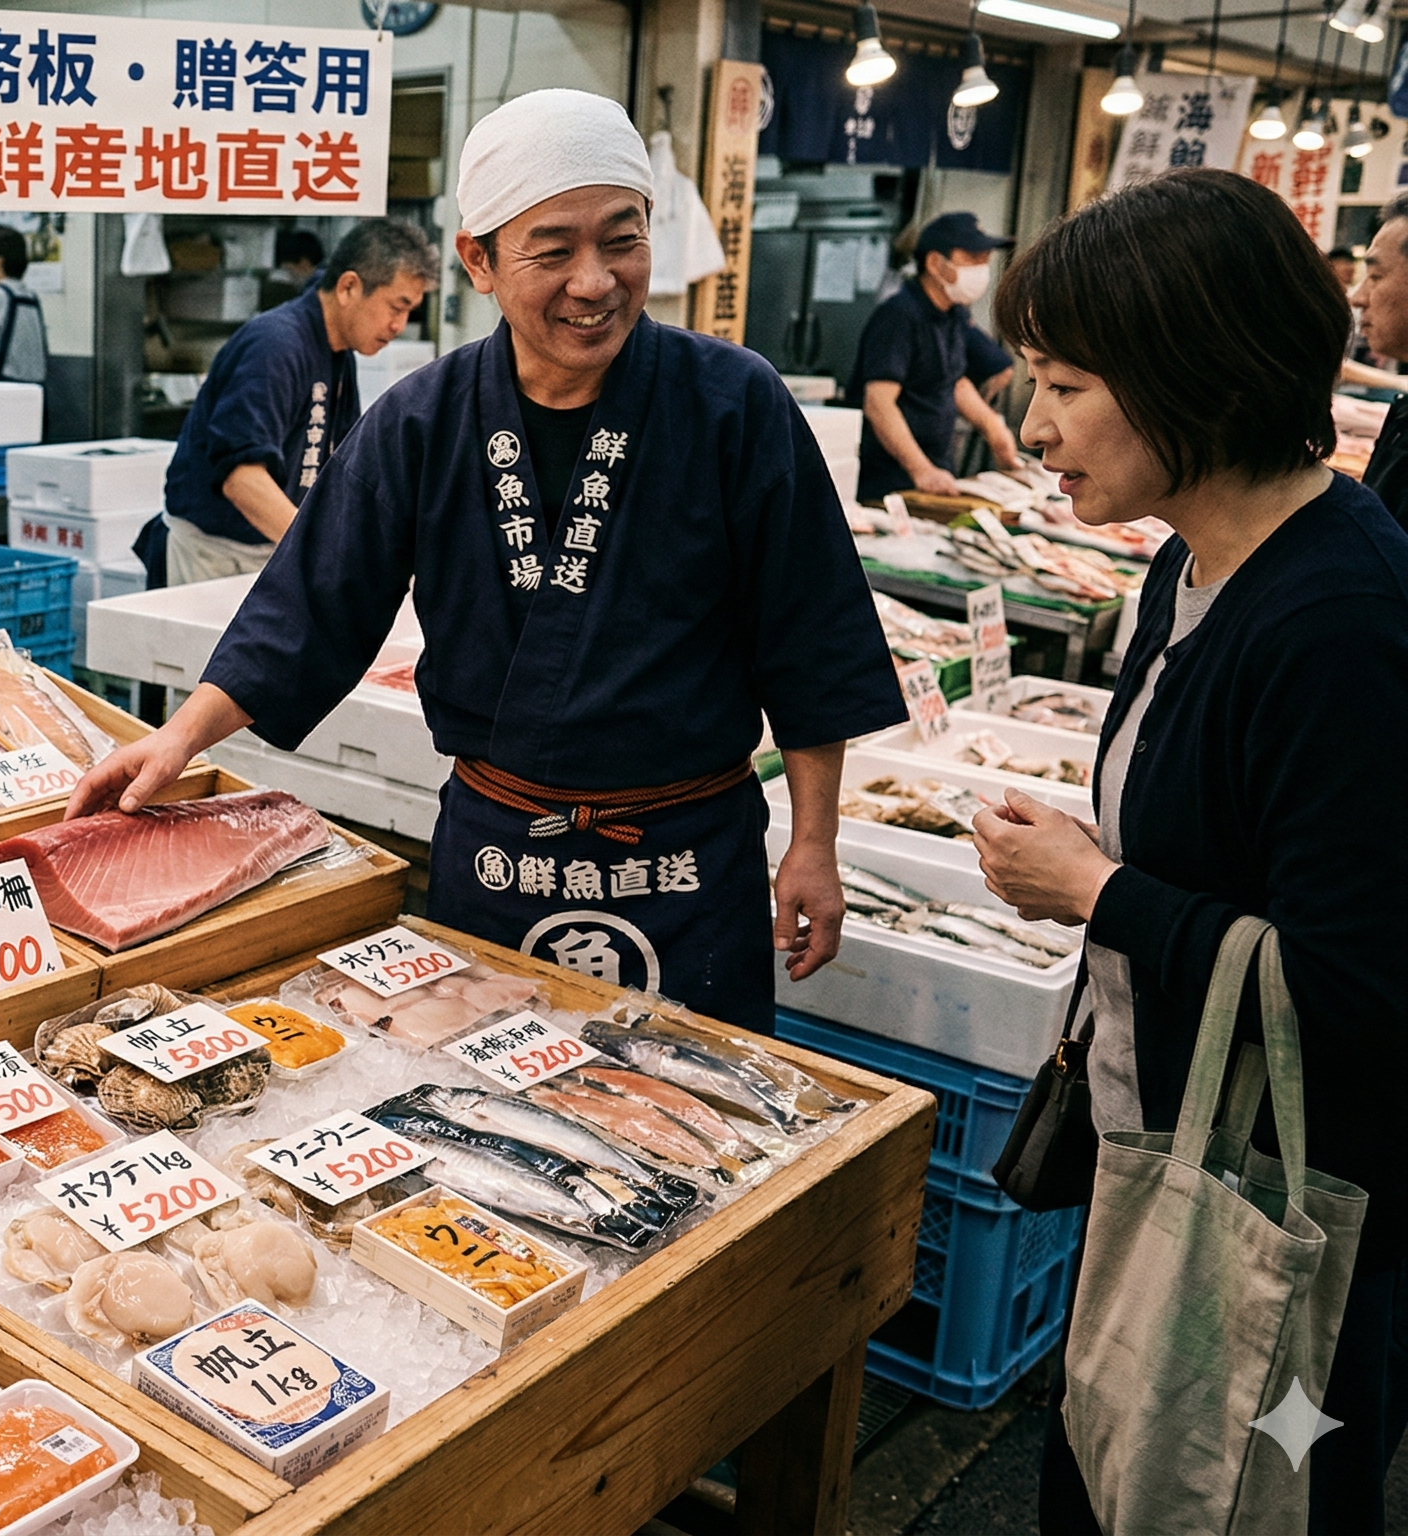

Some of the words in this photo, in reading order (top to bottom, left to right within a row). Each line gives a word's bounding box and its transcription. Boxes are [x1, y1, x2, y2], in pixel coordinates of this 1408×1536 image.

[495, 473, 544, 591] 魚市場
[550, 427, 628, 594] 鮮魚直送
[518, 850, 701, 900] 鮮魚直送
[127, 1017, 205, 1051] 帆立
[424, 1224, 500, 1267] ウニ
[191, 1328, 296, 1384] 帆立
[251, 1366, 317, 1406] 1kg
